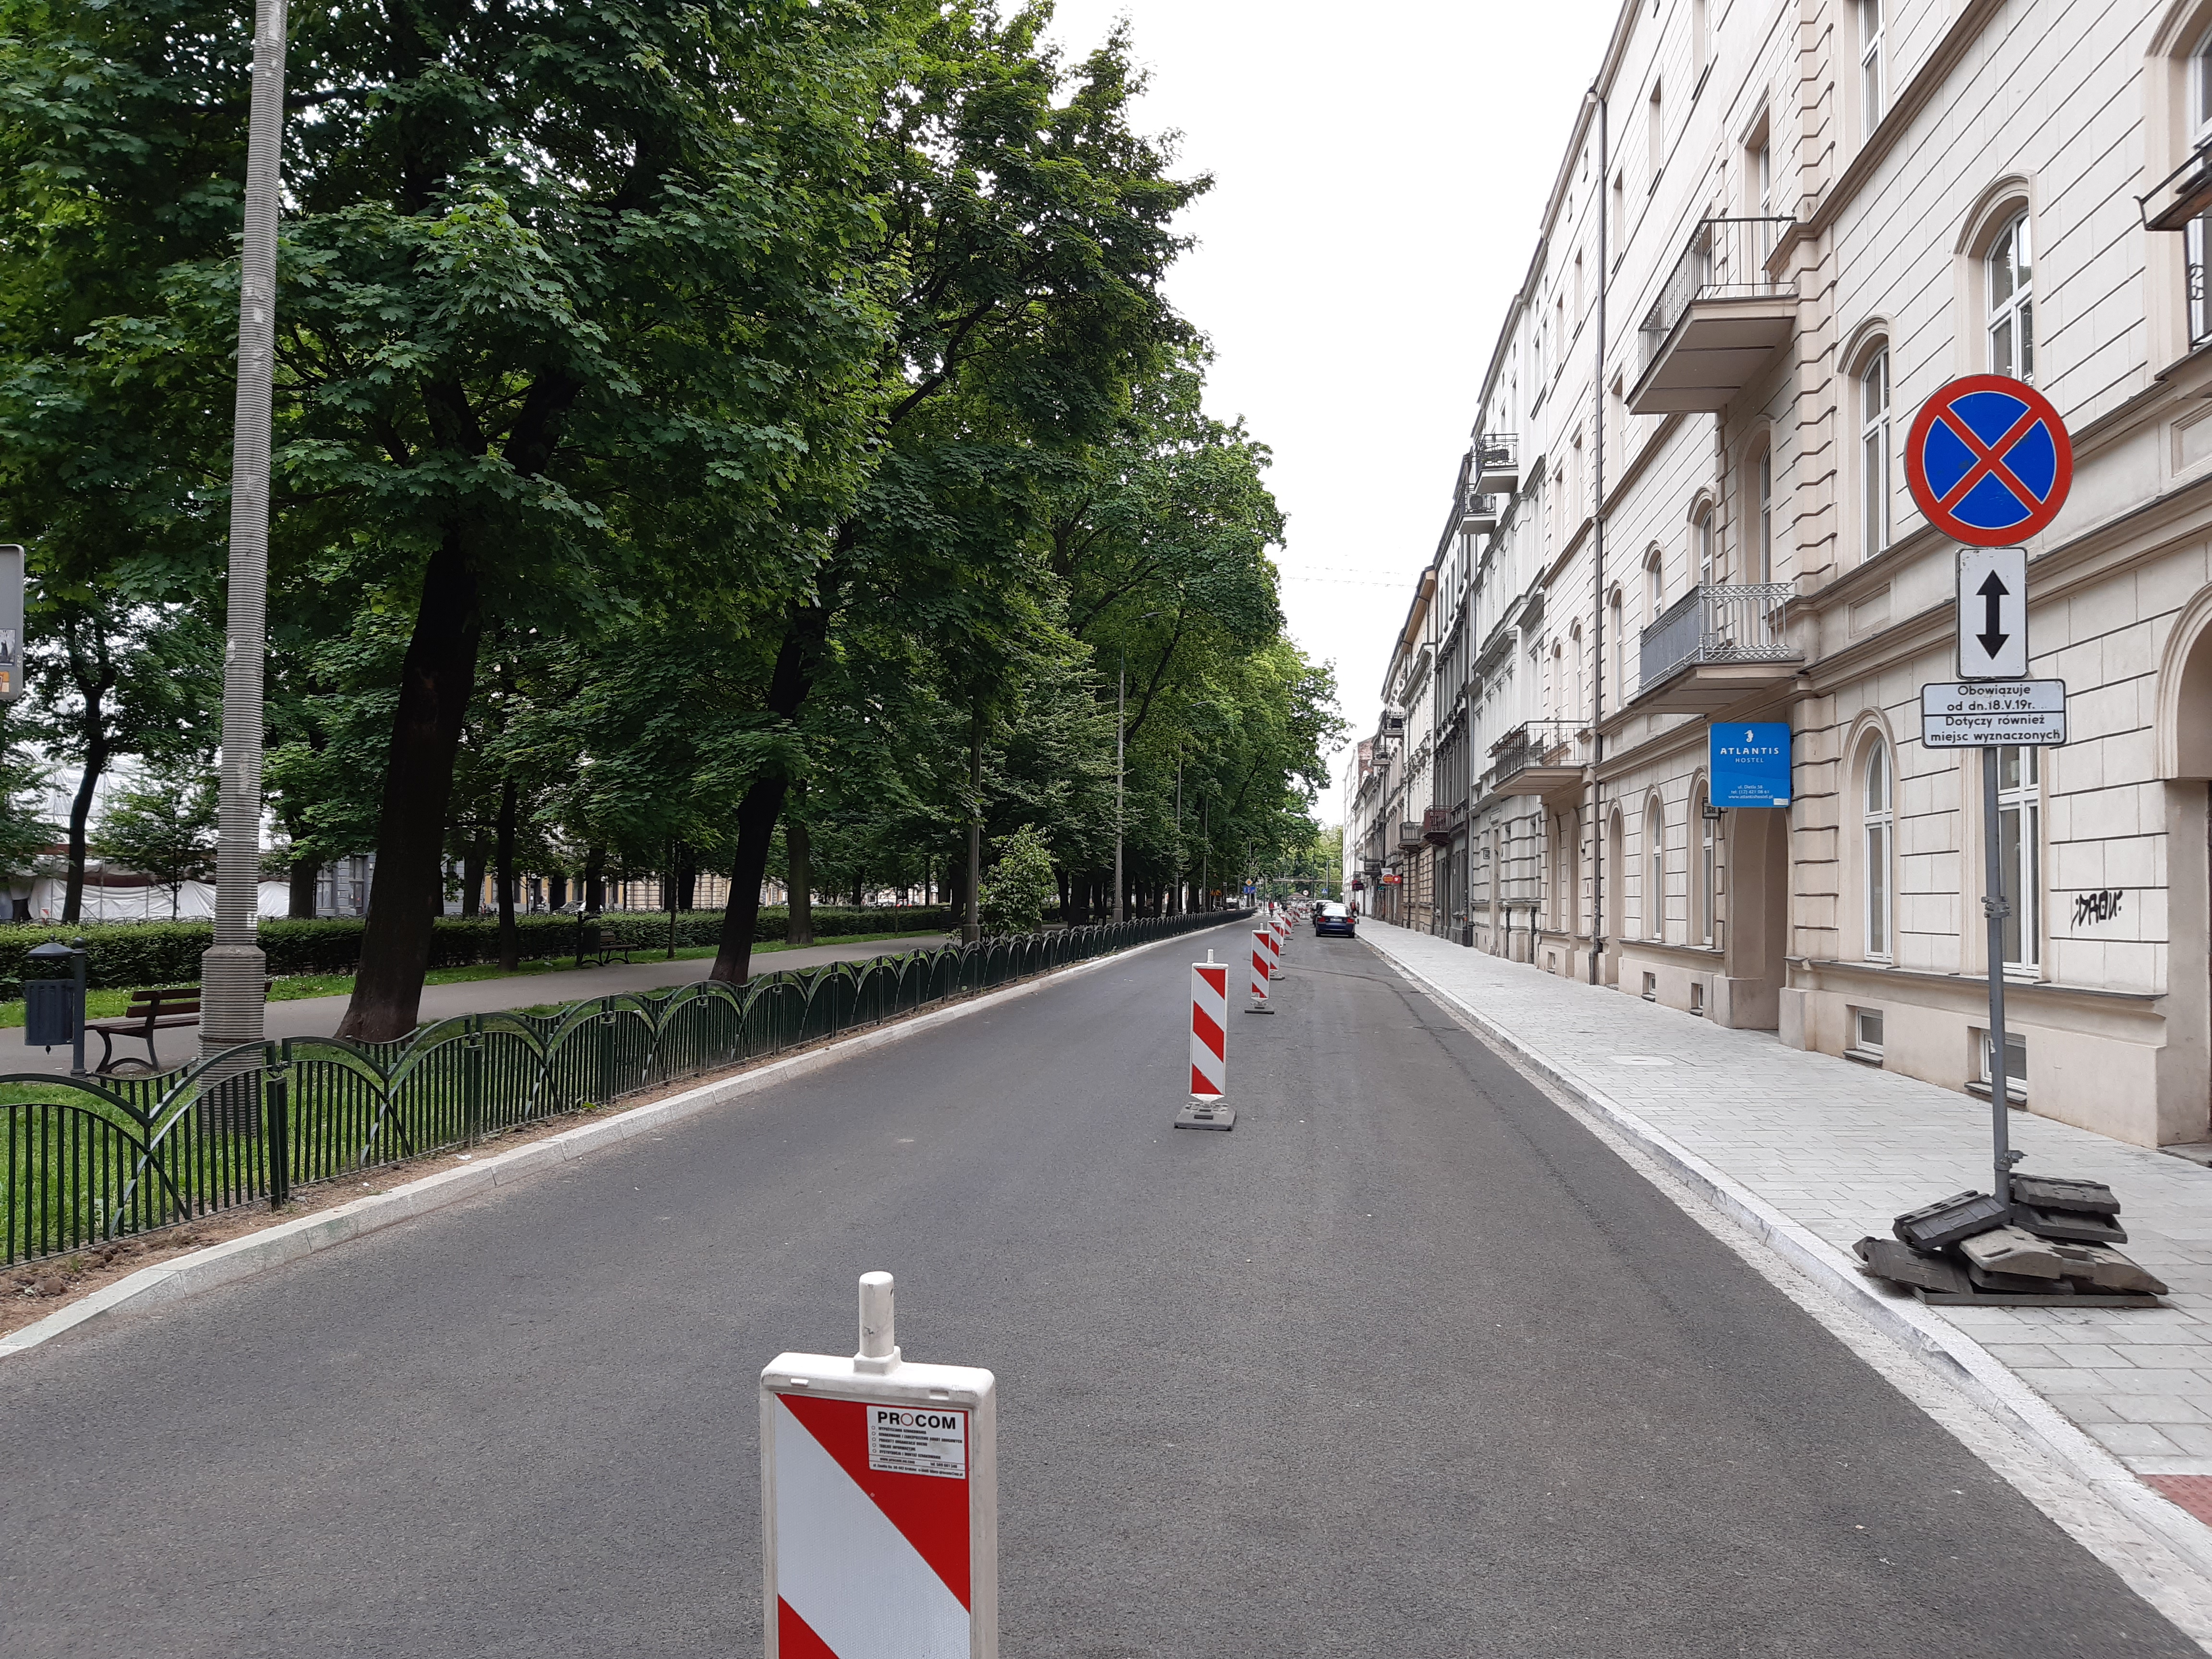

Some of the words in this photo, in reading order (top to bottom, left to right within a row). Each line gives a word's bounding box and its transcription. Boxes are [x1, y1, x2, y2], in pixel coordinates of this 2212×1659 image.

[1958, 684, 2031, 697] Obowiązuje
[1947, 701, 1963, 711] od
[1946, 716, 1993, 729] Dotyczy
[1998, 714, 2044, 725] również
[1931, 732, 1968, 743] miejsc
[1973, 729, 2060, 743] wyznaczonych
[878, 1411, 956, 1430] PROCOM
